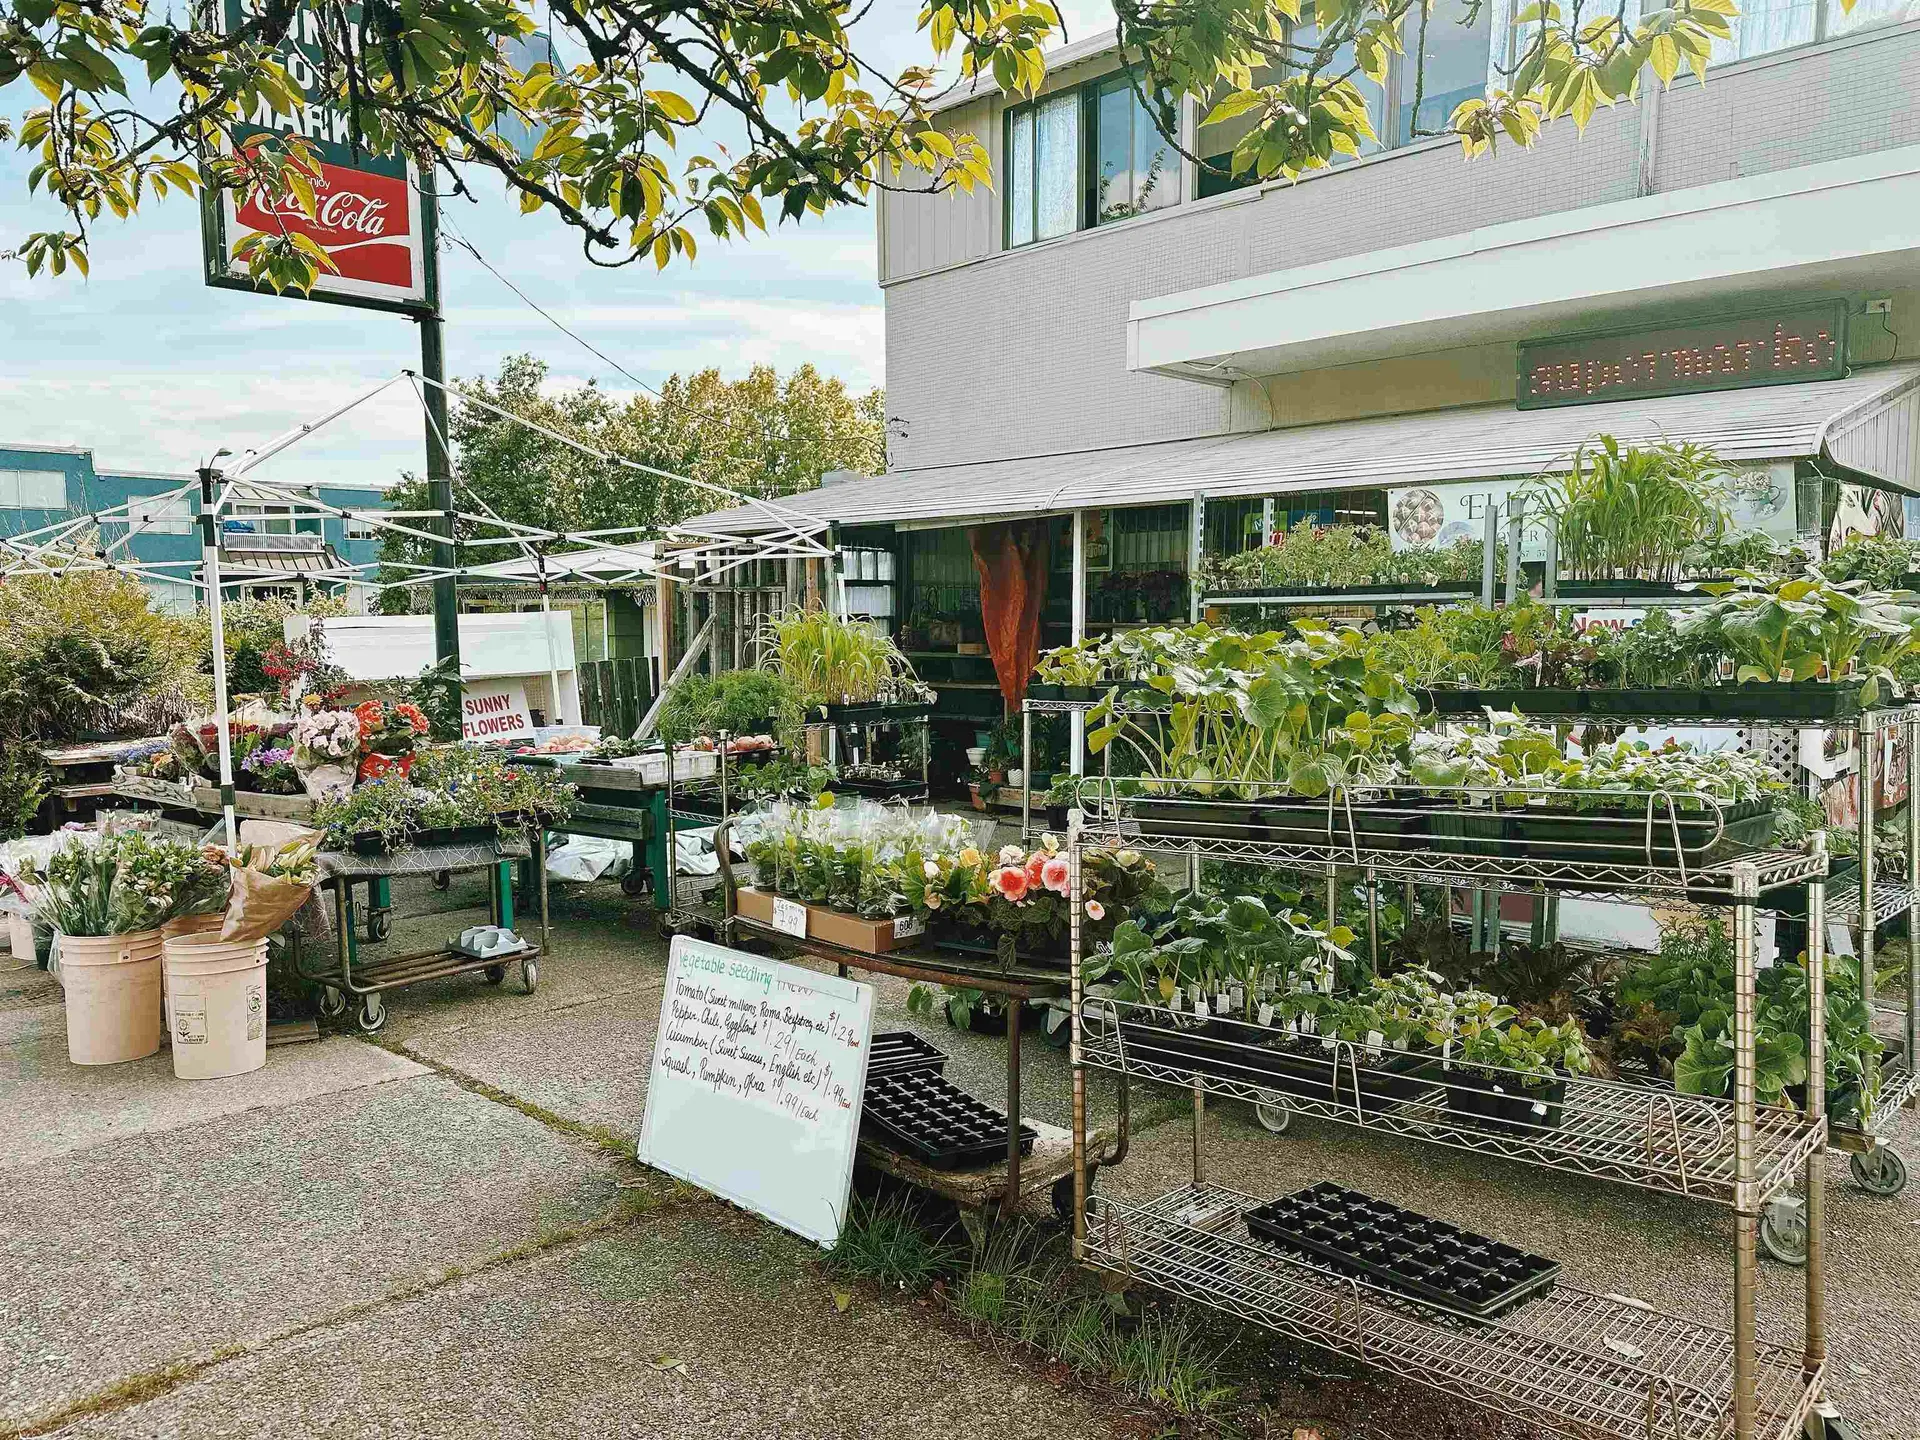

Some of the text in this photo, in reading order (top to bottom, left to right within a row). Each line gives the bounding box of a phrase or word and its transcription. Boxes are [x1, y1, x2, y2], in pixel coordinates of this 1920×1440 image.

[465, 694, 510, 716] SUNNY
[462, 713, 525, 738] FLOWERS
[679, 948, 772, 995] Vegetable seedling
[769, 1053, 801, 1082] English
